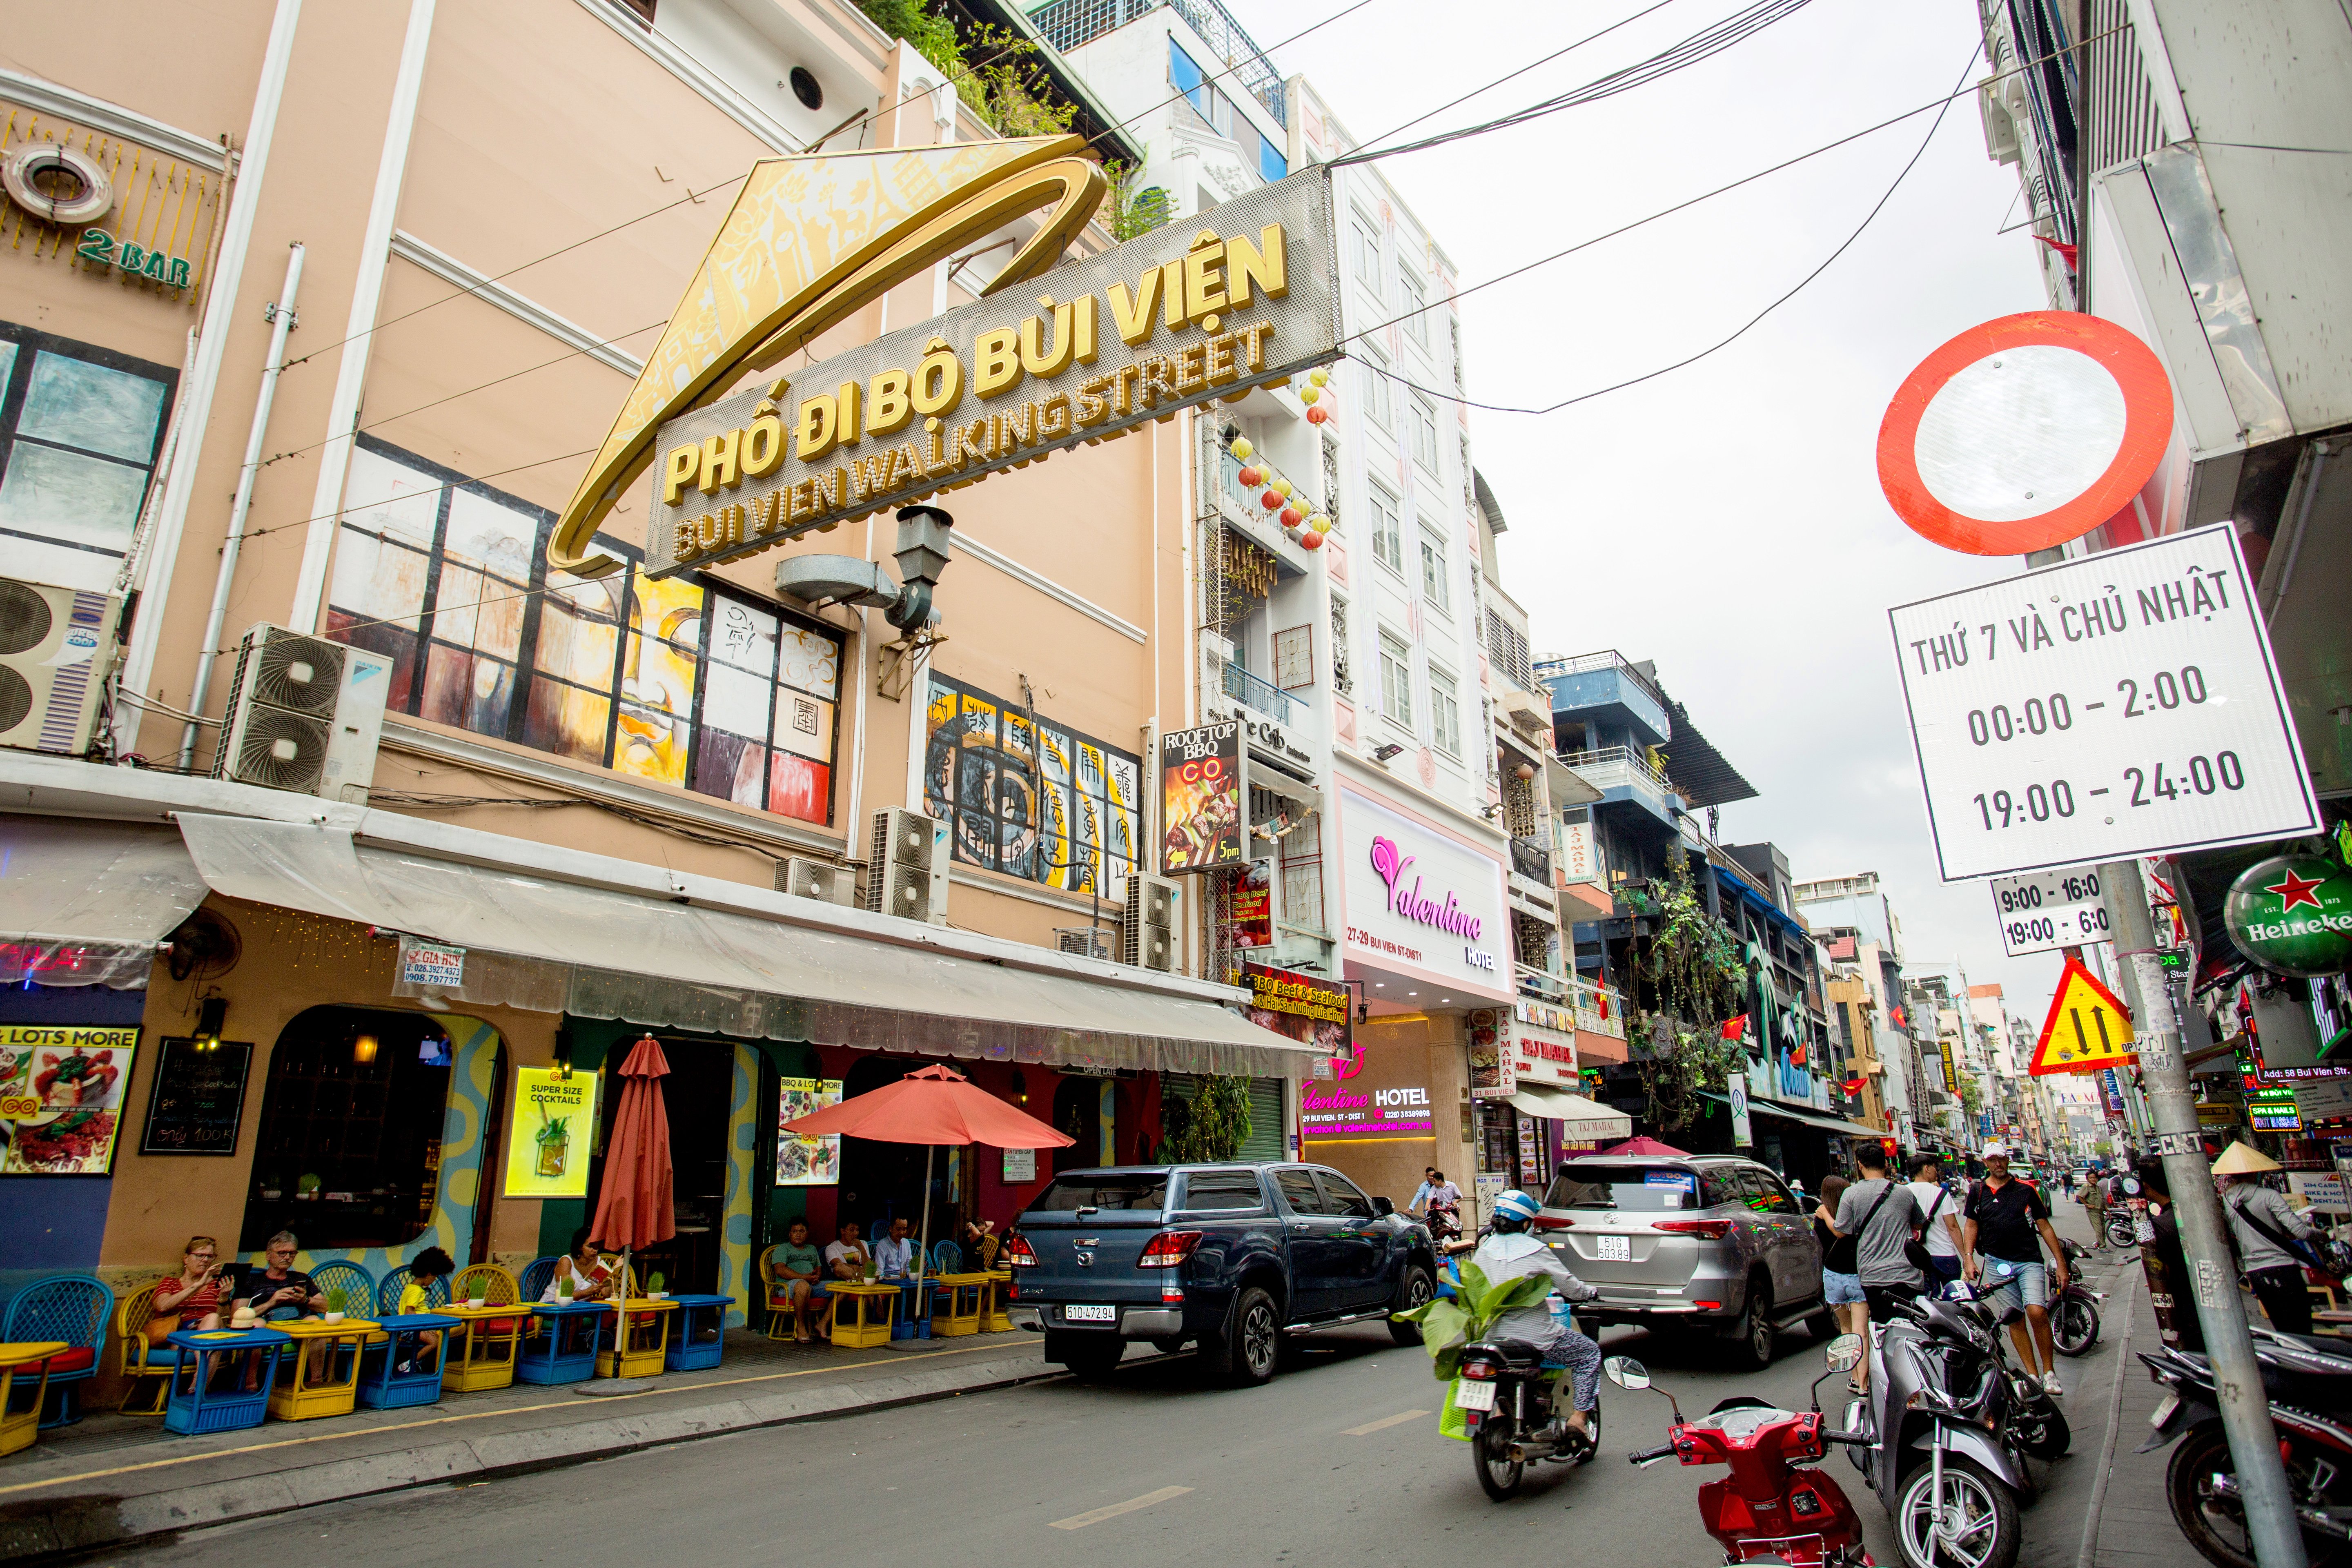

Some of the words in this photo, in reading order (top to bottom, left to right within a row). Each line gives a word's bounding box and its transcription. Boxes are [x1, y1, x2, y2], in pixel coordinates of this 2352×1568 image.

[78, 227, 116, 265] 2
[118, 240, 192, 290] BAR
[664, 379, 790, 507] PHỐ
[793, 380, 860, 463] ĐI
[865, 336, 965, 436] BỘ
[973, 294, 1098, 400] BÙI
[1106, 223, 1289, 347] VIỆN
[673, 504, 744, 563] BUI
[749, 467, 847, 536] VIEN
[849, 391, 1071, 503] WALKING
[1076, 320, 1274, 428] STREET
[1911, 621, 1969, 675] THỨ
[1981, 624, 1996, 660] 7
[2009, 604, 2054, 653] VÀ
[2060, 585, 2127, 642] CHỦ
[2137, 565, 2230, 626] NHẬT
[356, 660, 382, 671] DAIKIN
[1968, 693, 2072, 746] 00:00
[2085, 701, 2106, 710] -
[2118, 666, 2207, 718] 2:00
[1165, 722, 1237, 750] ROOFTOP
[1259, 722, 1285, 749] Crib
[1183, 740, 1218, 760] BBQ
[1974, 780, 2075, 831] 19:00
[2089, 787, 2109, 795] -
[2124, 751, 2245, 807] 24:00
[1570, 826, 1583, 843] TAJ
[1220, 840, 1239, 860] 5pm
[1570, 845, 1586, 873] MAHAL
[1251, 889, 1268, 898] Beef
[1370, 839, 1482, 940] Valentine
[2001, 885, 2042, 912] 9:00
[2061, 874, 2100, 901] 16:0
[1233, 899, 1262, 909] Seafood
[2007, 917, 2054, 946] 19:00
[2078, 907, 2109, 933] 6:0
[2246, 914, 2352, 942] Heineke
[1348, 927, 1369, 945] 27-29
[1370, 936, 1381, 949] BUI
[1382, 940, 1396, 954] VIEN
[423, 951, 439, 964] GIA
[441, 953, 461, 966] HUY
[1466, 947, 1497, 971] HOTEL
[405, 973, 459, 984] 0908.797737
[1259, 995, 1265, 1009] &
[1274, 980, 1299, 998] Beef
[1300, 985, 1308, 1000] &
[1309, 988, 1348, 1009] Seafood
[1500, 1010, 1510, 1036] TAJ
[10, 1029, 66, 1044] LOTS
[72, 1031, 134, 1047] MORE
[1521, 1038, 1539, 1057] TAJ
[1540, 1042, 1573, 1063] MAHAL
[1941, 1044, 1951, 1062] HOSTEL
[1083, 1066, 1101, 1074] OPEN
[1500, 1040, 1512, 1084] MAHAL
[1944, 1062, 1953, 1082] FLIPSIDE
[2264, 1069, 2283, 1078] Add:
[2334, 1067, 2351, 1075] Str.
[531, 1085, 561, 1094] SUPER
[563, 1087, 583, 1095] SIZE
[782, 1079, 796, 1087] BBQ
[1498, 1087, 1514, 1096] VIỆN
[530, 1094, 581, 1105] COCKTAILS
[1375, 1088, 1430, 1107] HOTEL
[1384, 1110, 1399, 1119] (028)
[1400, 1110, 1430, 1118] 38389898
[1303, 1125, 1334, 1134] ervation
[1343, 1121, 1432, 1132] valentinehotel.com.vn
[1578, 1122, 1590, 1132] TAJ
[1591, 1121, 1616, 1131] MAHAL
[1605, 1237, 1621, 1248] 51G
[1599, 1248, 1628, 1259] 503.89
